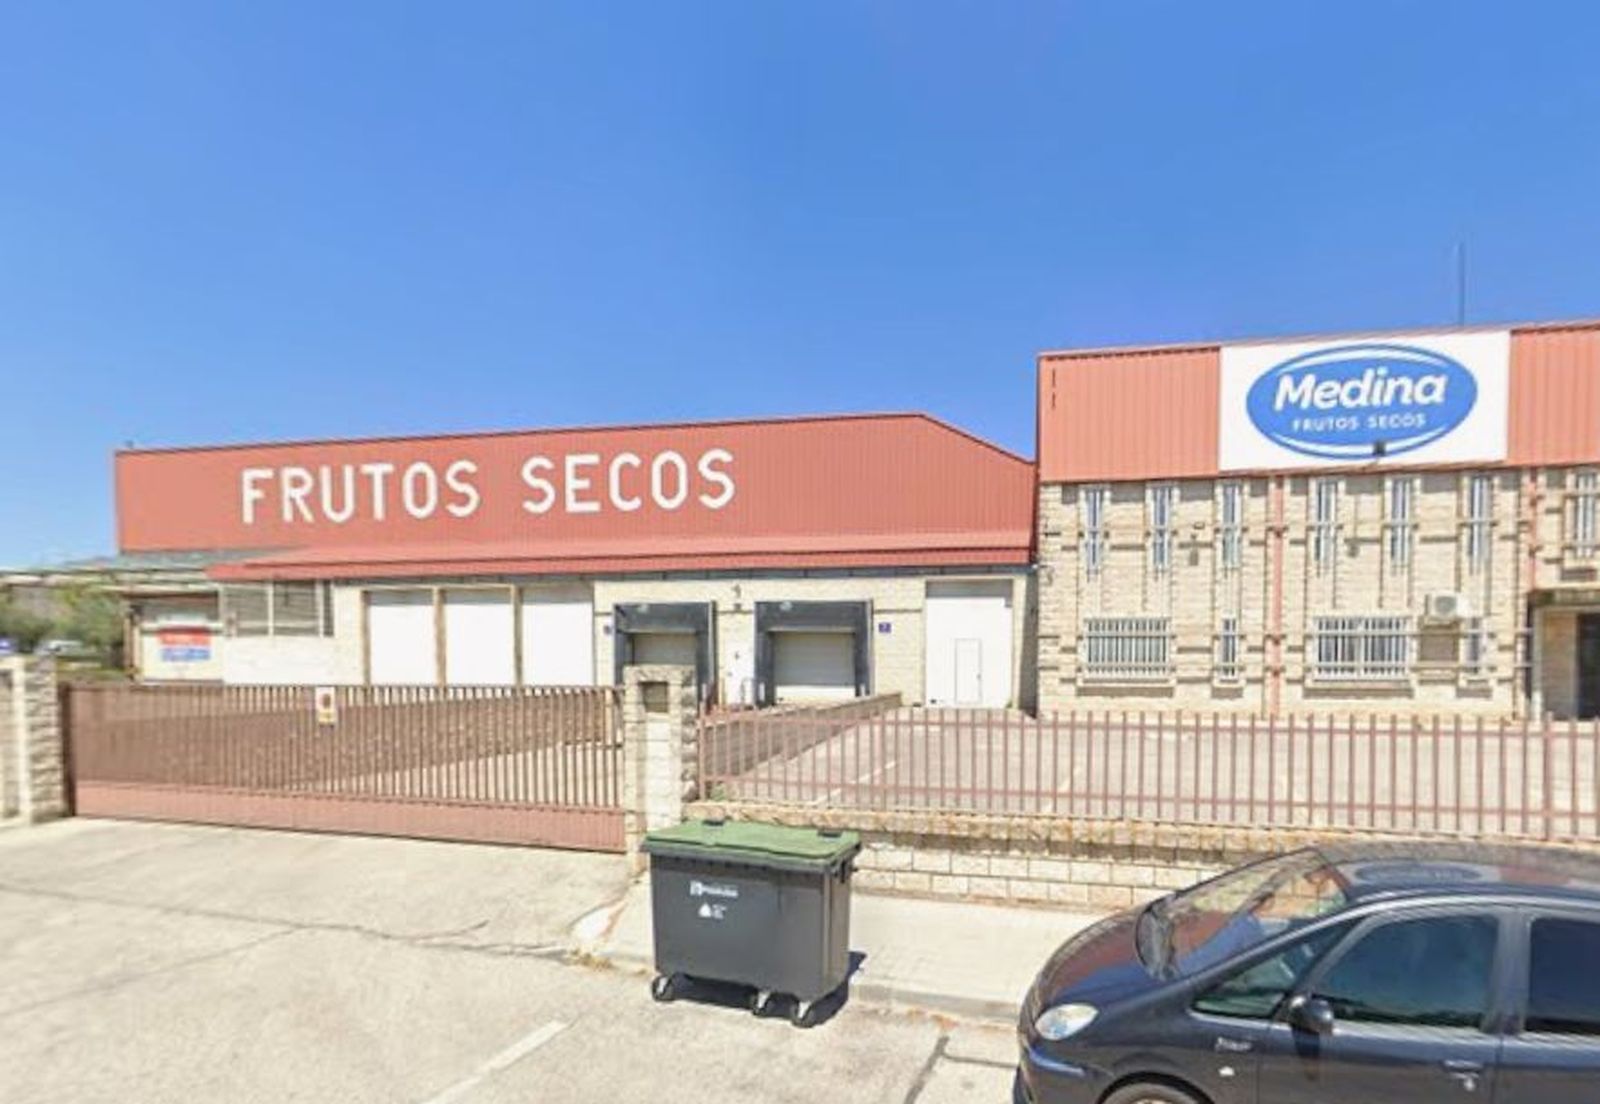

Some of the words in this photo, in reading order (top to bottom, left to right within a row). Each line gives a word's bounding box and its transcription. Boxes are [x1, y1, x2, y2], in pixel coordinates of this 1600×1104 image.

[1274, 367, 1448, 411] Medina
[1292, 415, 1359, 432] FRUTOS
[1367, 412, 1426, 430] SECOS
[241, 460, 480, 523] FRUTOS
[521, 449, 735, 514] SECOS
